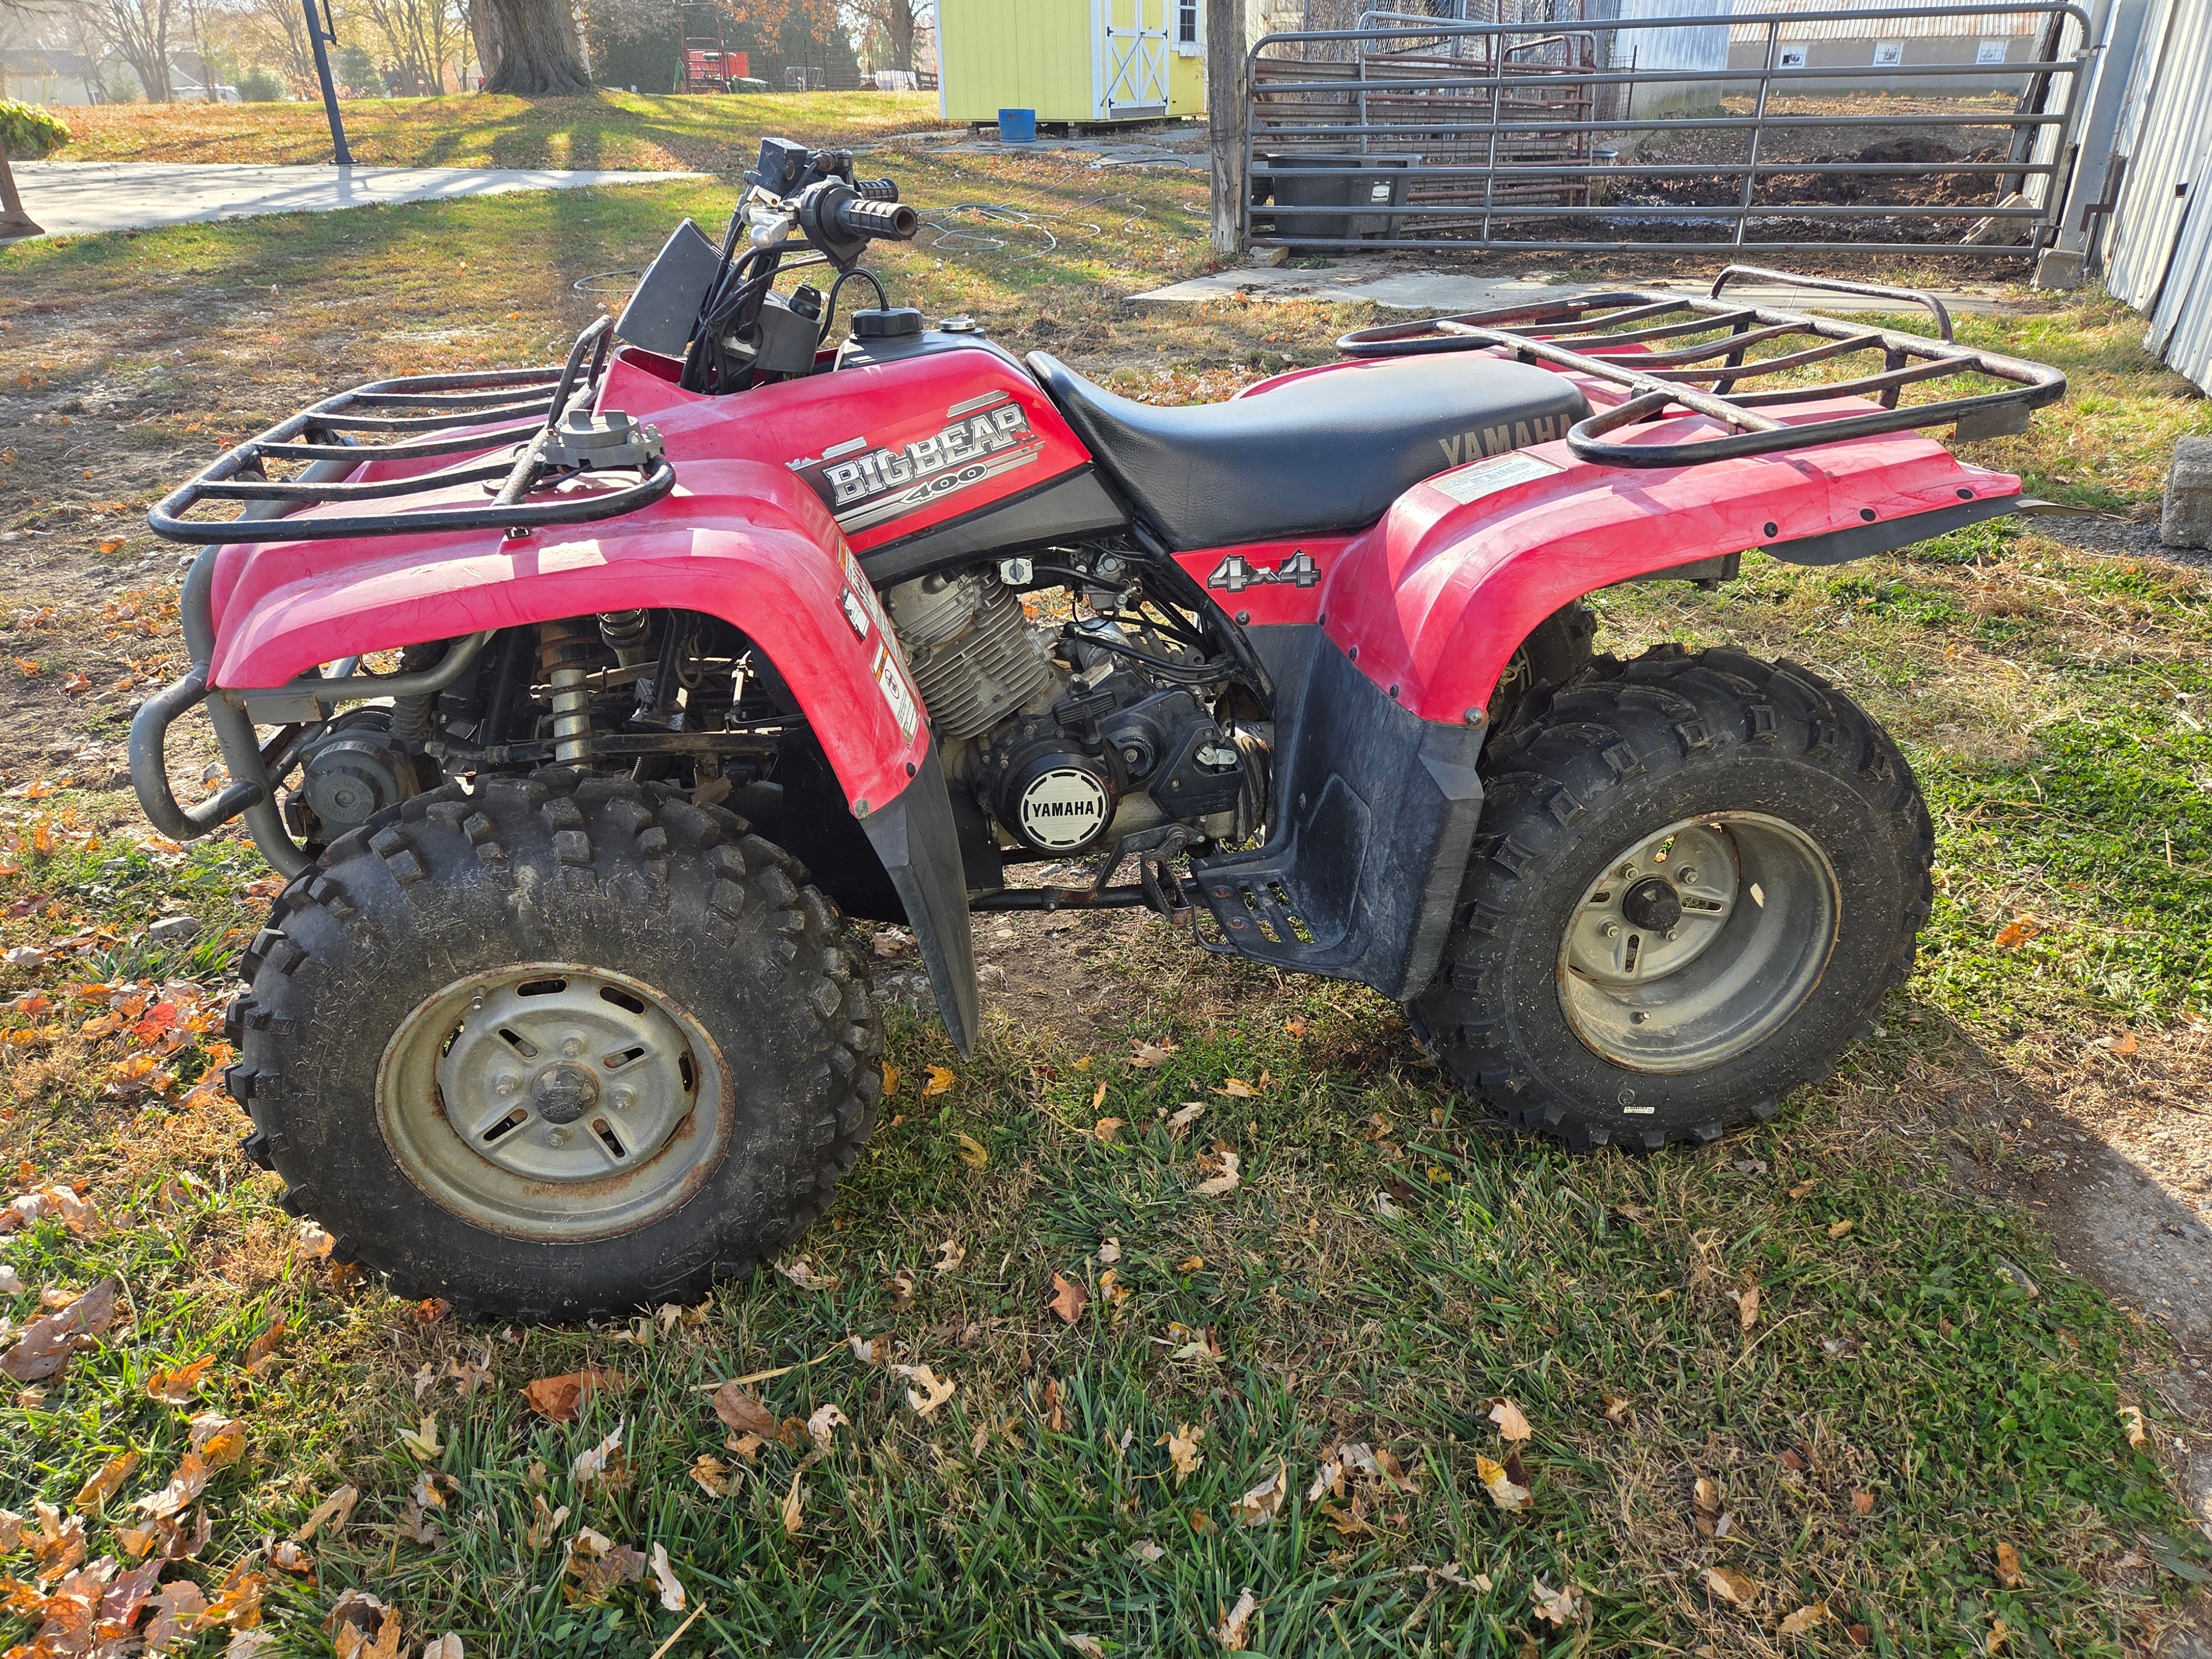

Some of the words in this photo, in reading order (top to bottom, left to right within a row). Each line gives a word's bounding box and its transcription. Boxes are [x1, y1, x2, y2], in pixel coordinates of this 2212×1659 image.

[1439, 414, 1572, 467] YAMAHA
[900, 462, 988, 505] 400
[1032, 801, 1094, 817] YAMAHA
